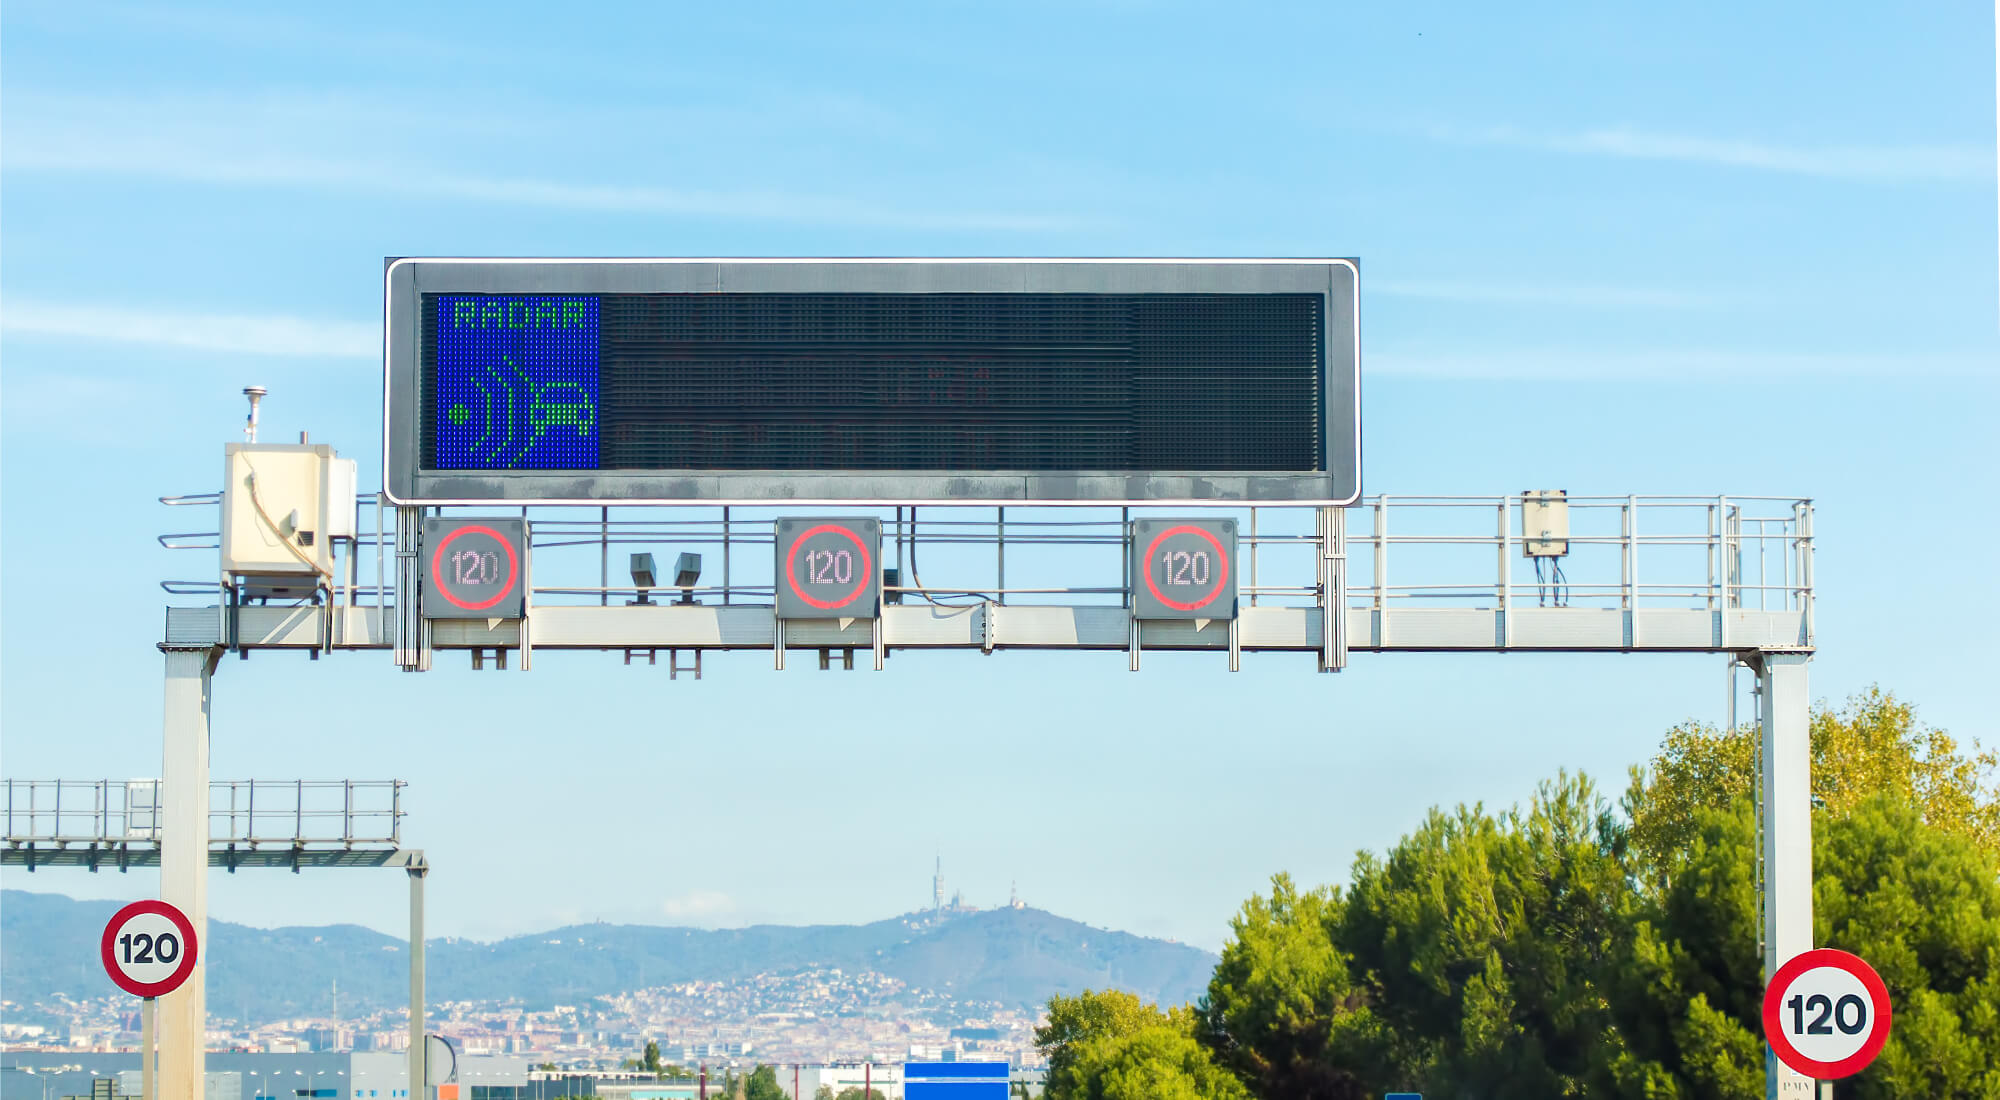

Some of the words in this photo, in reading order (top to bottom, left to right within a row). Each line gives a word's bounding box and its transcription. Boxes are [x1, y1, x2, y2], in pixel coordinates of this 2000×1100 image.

[455, 301, 584, 328] RADAR
[452, 551, 498, 584] 120
[806, 550, 852, 584] 120
[1163, 551, 1209, 584] 120
[119, 932, 179, 964] 120
[1787, 994, 1867, 1035] 120
